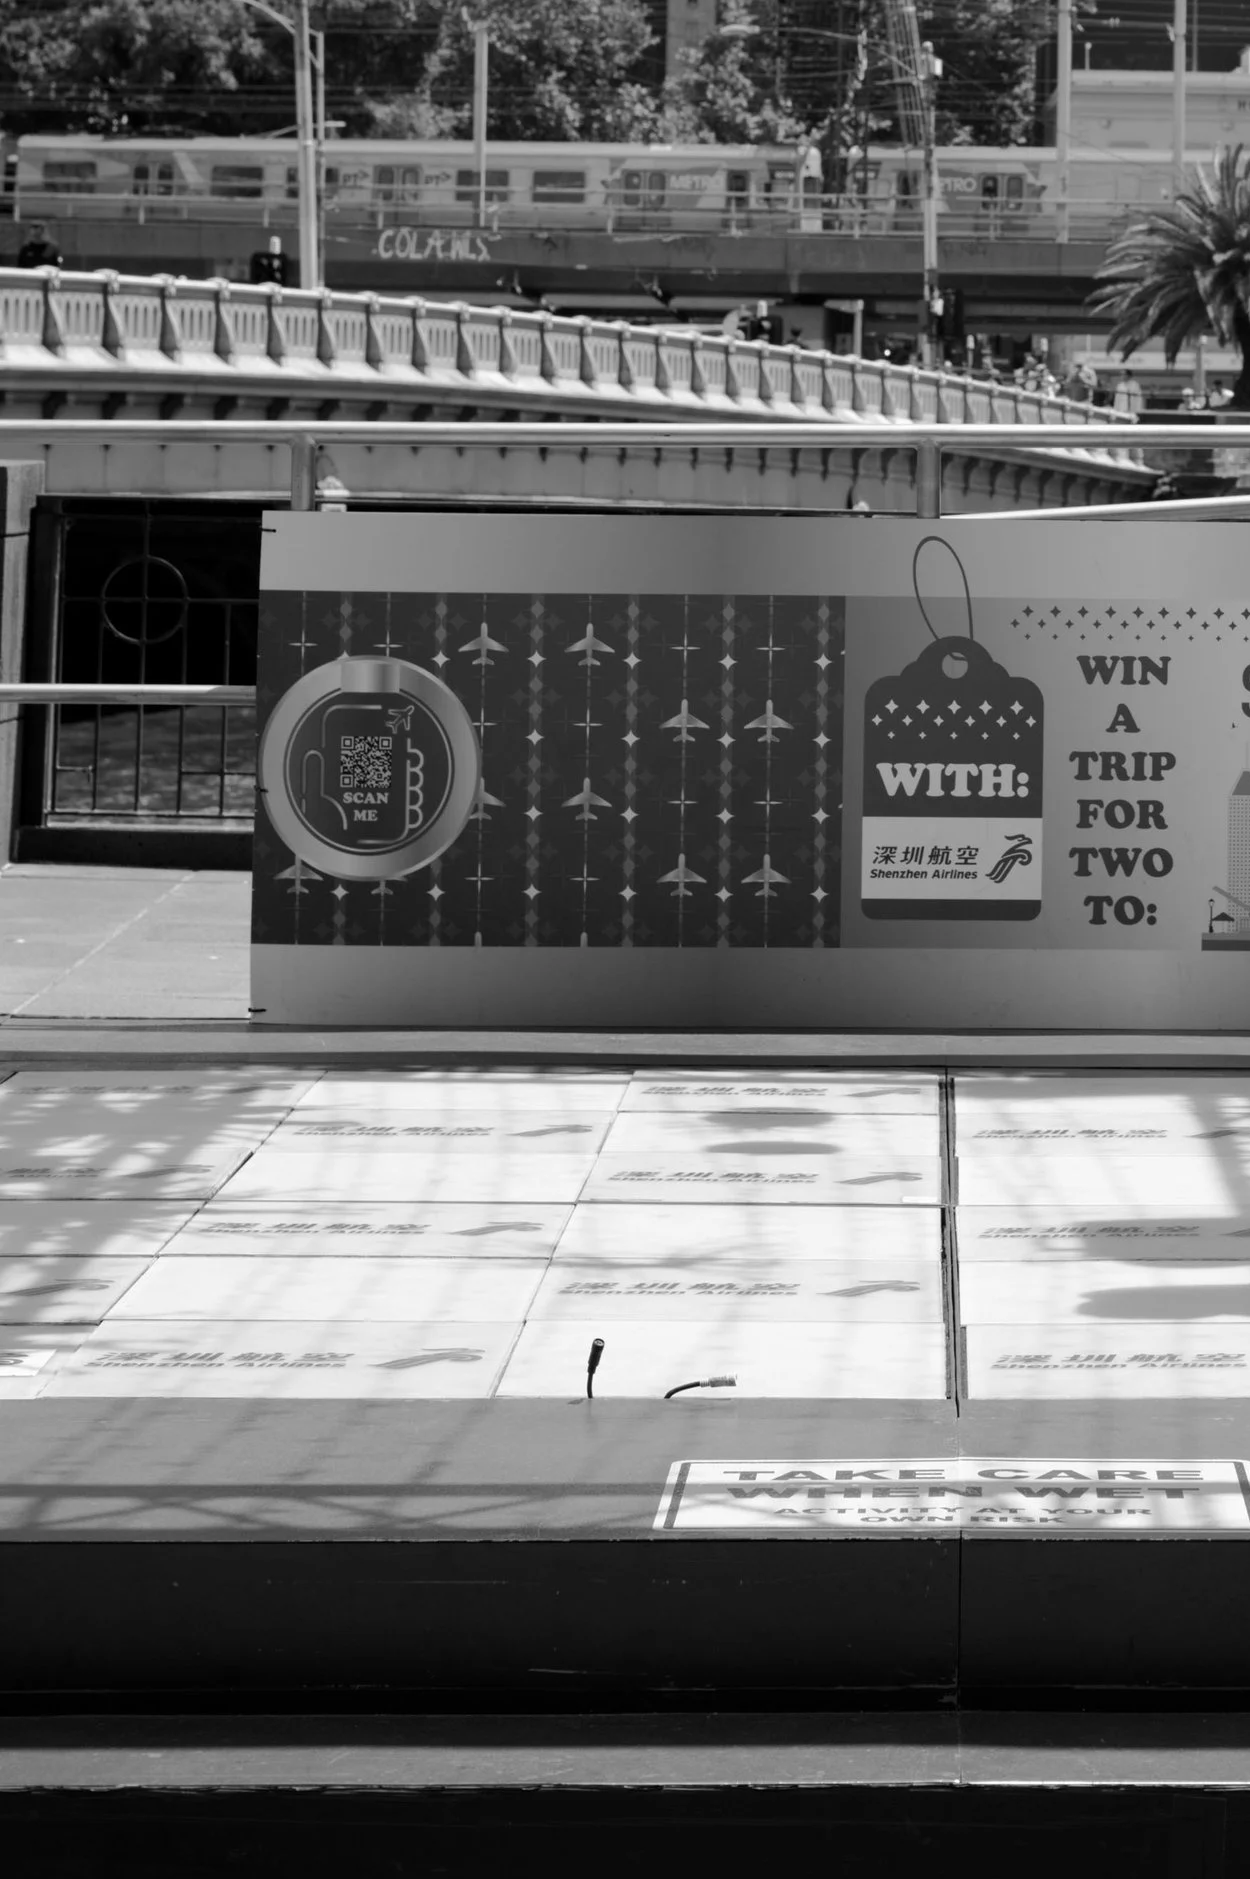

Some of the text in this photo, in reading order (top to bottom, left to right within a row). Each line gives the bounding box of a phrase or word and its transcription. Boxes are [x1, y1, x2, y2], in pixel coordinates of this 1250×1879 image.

[937, 177, 977, 193] ETRO
[1076, 655, 1171, 686] WIN
[1105, 703, 1141, 733] A
[1068, 751, 1176, 782] TRIP
[876, 762, 1030, 798] WITH:
[342, 792, 389, 805] SCAN
[353, 809, 379, 822] ME
[1075, 798, 1168, 830] FOR
[871, 845, 979, 867] 深圳航空
[1068, 847, 1174, 877] TWO
[869, 868, 978, 880] Shenzhen Airlines
[1083, 895, 1157, 926] TO:
[723, 1469, 1204, 1481] TAKE CARE
[726, 1486, 1200, 1499] WHEN WET
[859, 1515, 1068, 1523] OWN RISK
